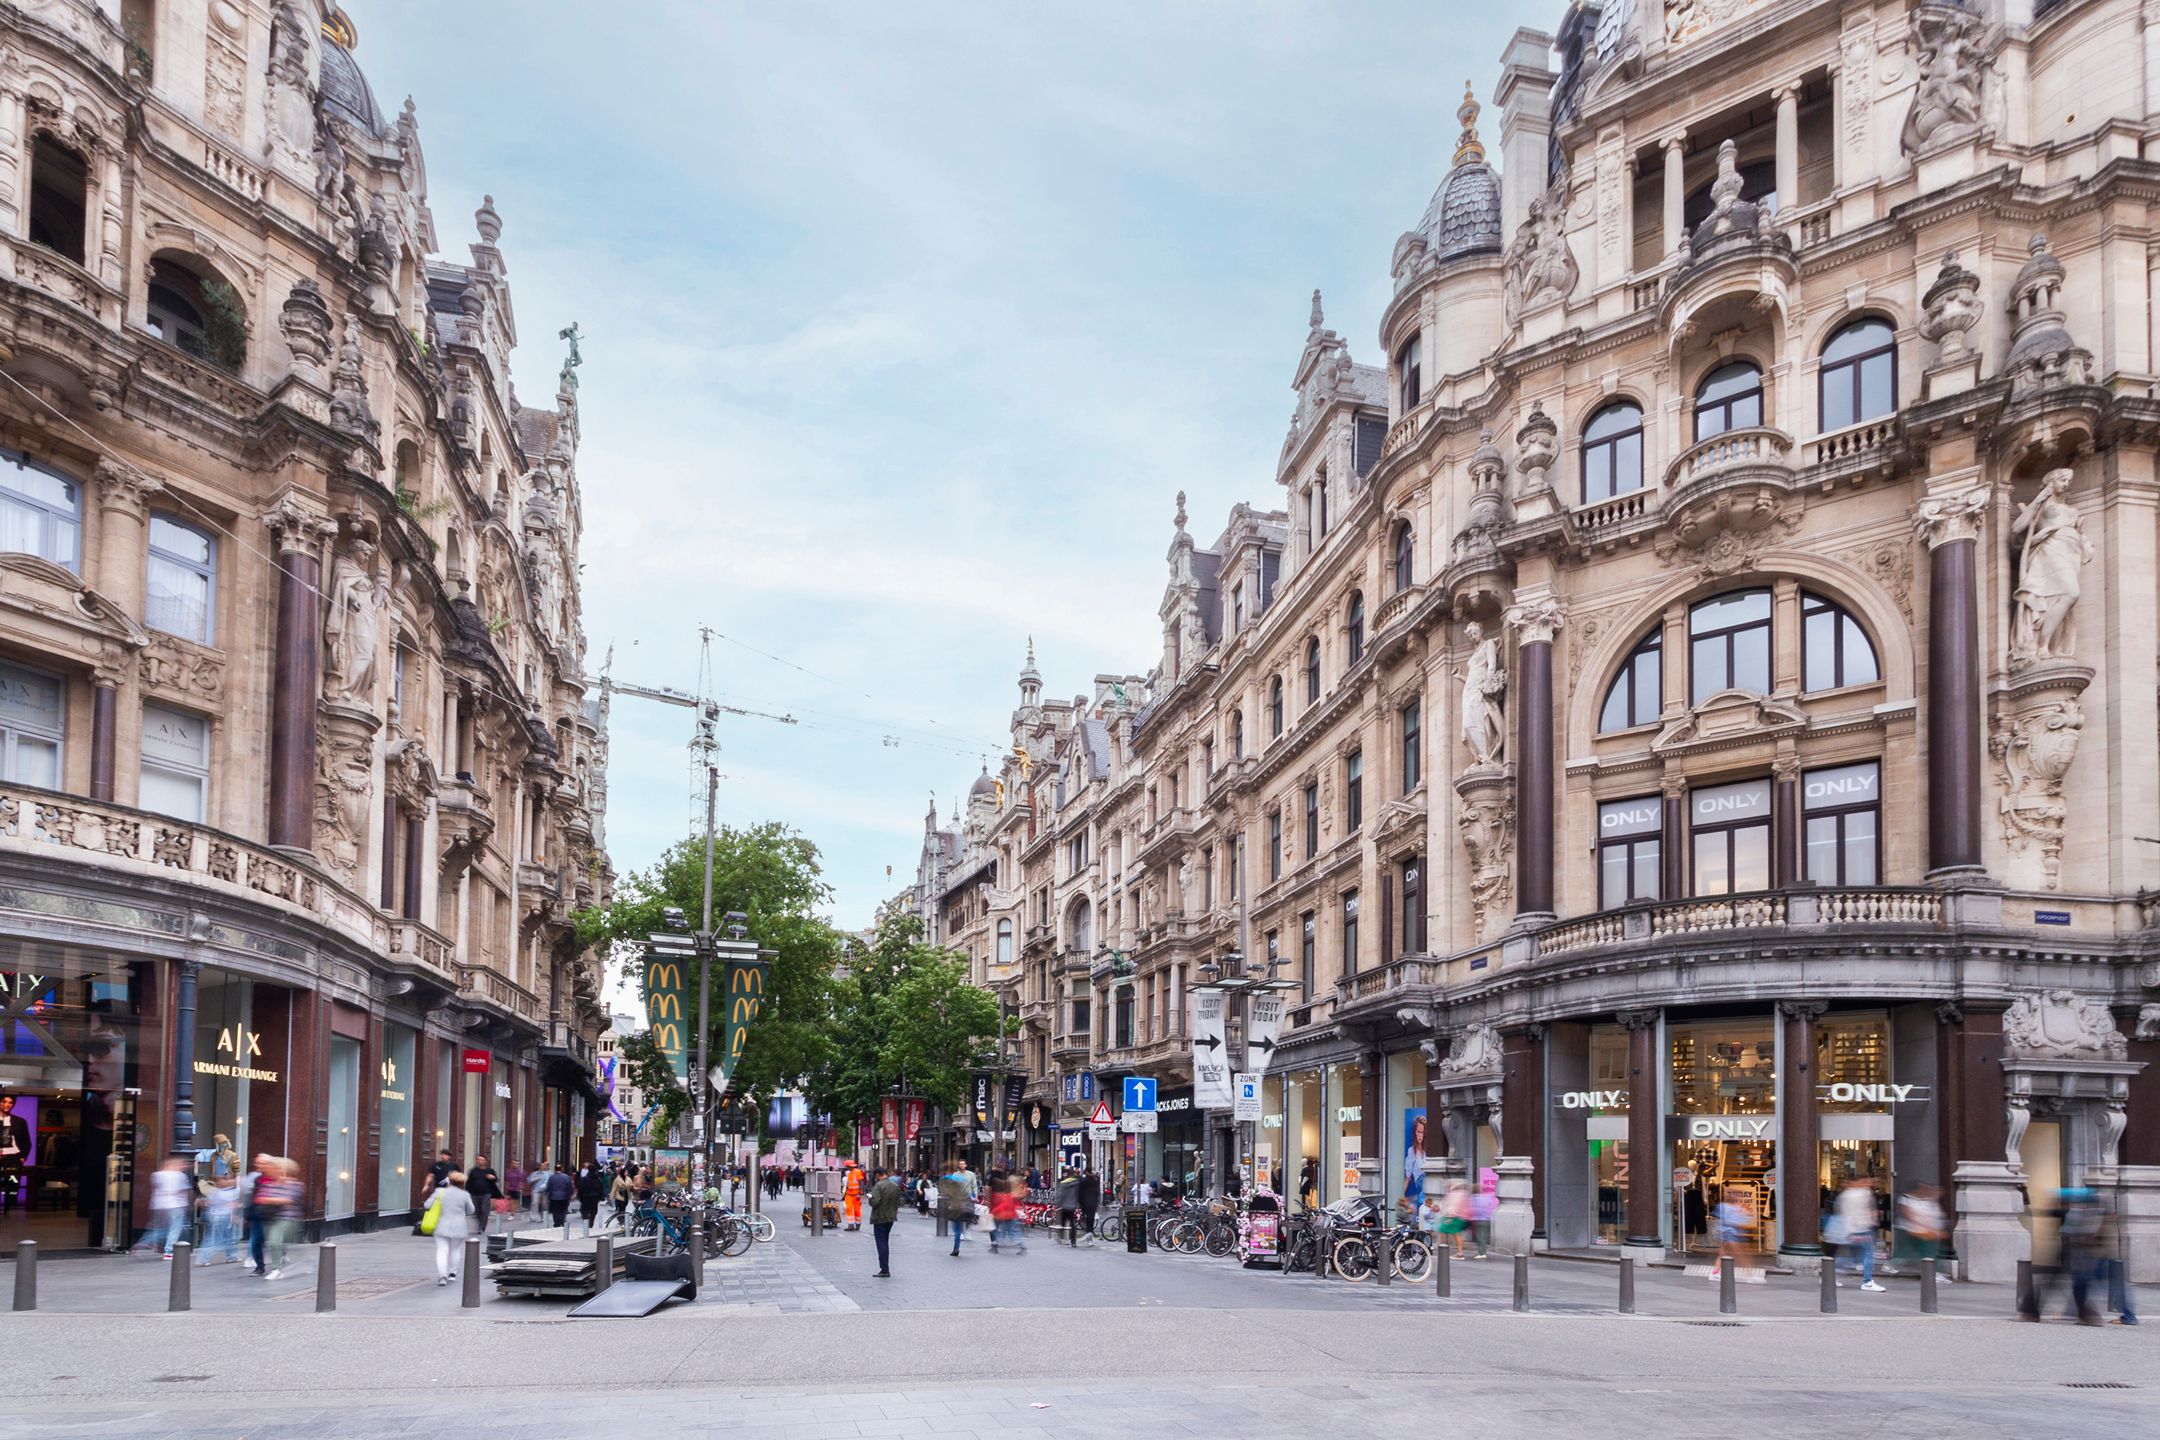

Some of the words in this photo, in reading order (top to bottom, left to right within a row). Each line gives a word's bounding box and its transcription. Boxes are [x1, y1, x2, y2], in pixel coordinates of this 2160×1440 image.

[1806, 774, 1876, 798] ONLY
[1699, 791, 1762, 813] ONLY
[1601, 807, 1660, 828] ONLY
[1252, 1011, 1280, 1023] TODAY
[217, 1022, 262, 1061] A|X
[193, 1061, 230, 1076] ARMANI
[231, 1066, 279, 1083] EXCHANGE
[976, 1079, 986, 1110] fnac
[1562, 1090, 1621, 1109] ONLY
[1830, 1082, 1914, 1103] ONLY
[1157, 1097, 1189, 1113] ACK&JONES
[1692, 1120, 1769, 1138] ONLY
